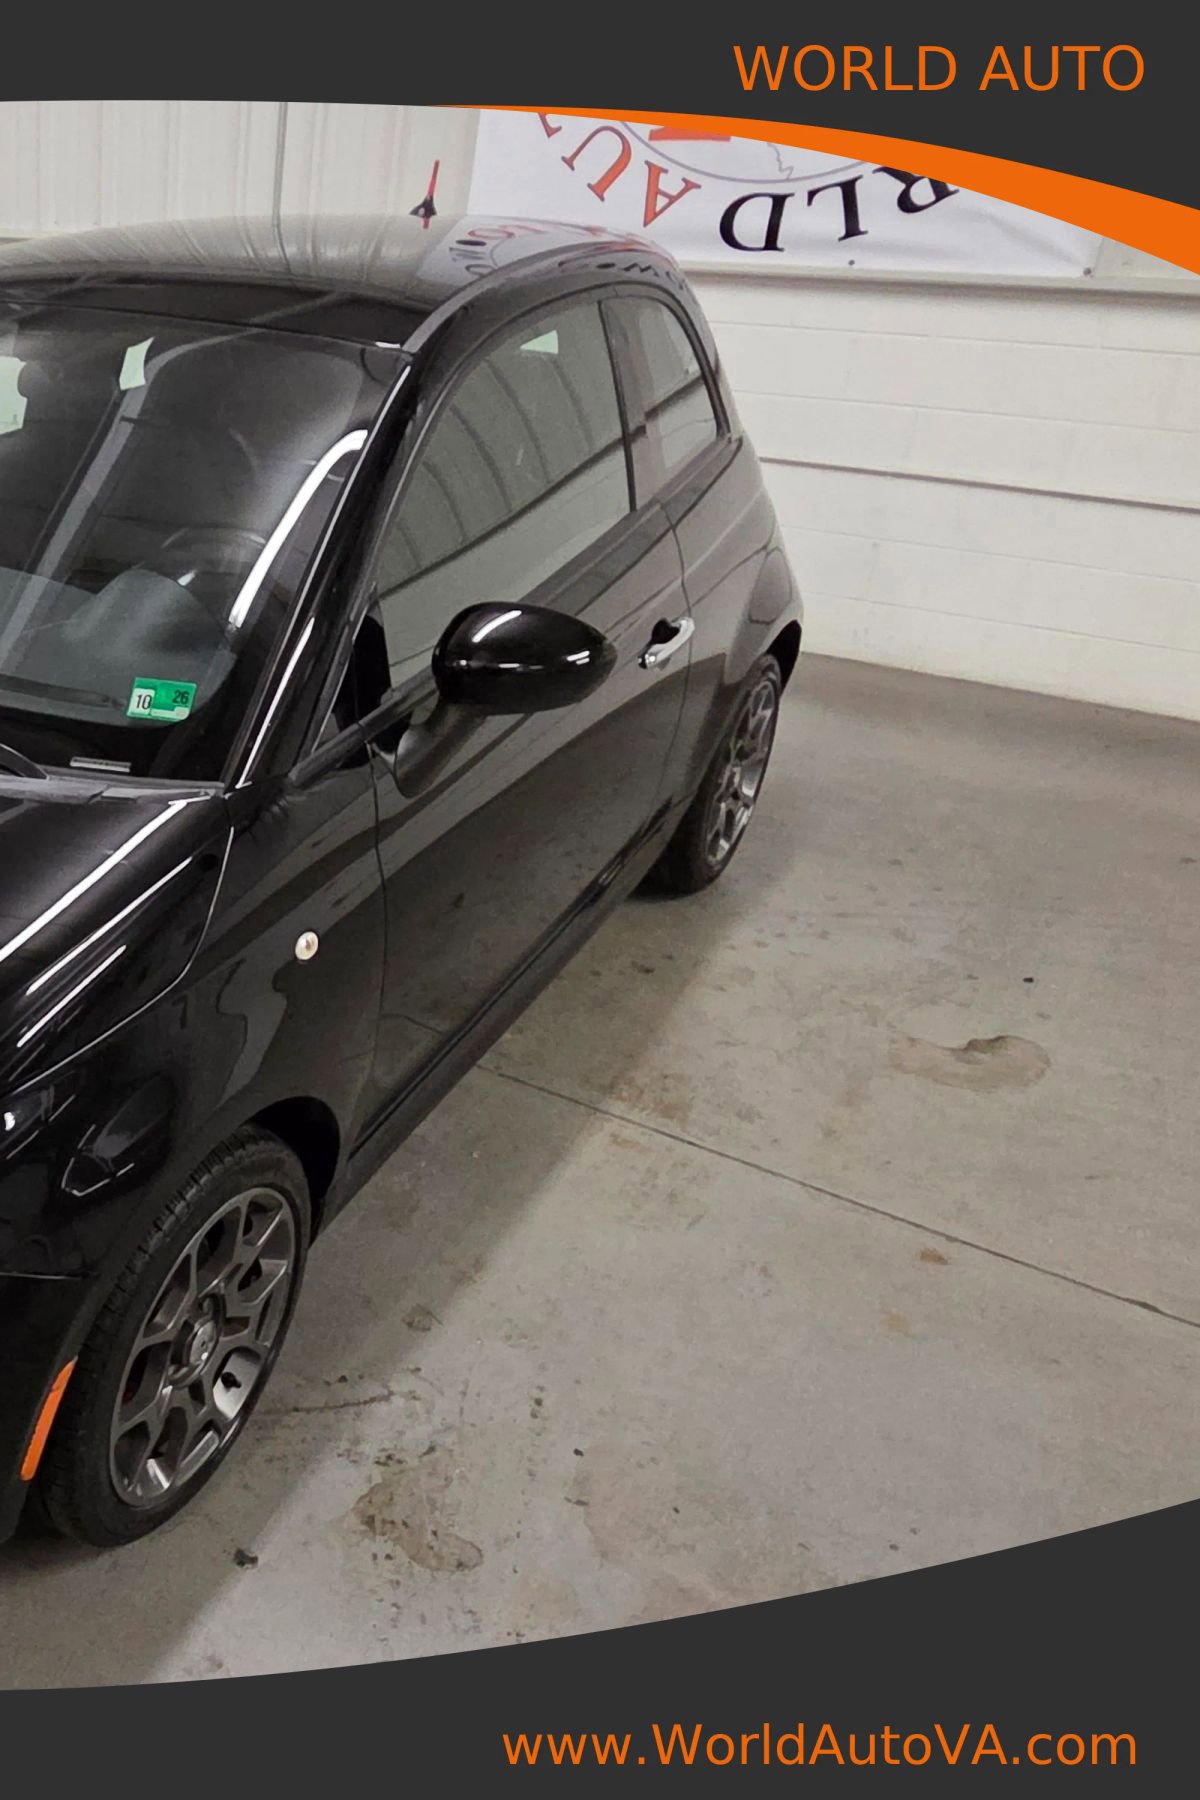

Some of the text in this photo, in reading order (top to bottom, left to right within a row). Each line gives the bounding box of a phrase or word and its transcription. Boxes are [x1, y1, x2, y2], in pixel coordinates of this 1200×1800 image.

[537, 113, 959, 252] RLD AU
[136, 694, 153, 710] 10
[172, 689, 190, 705] 26
